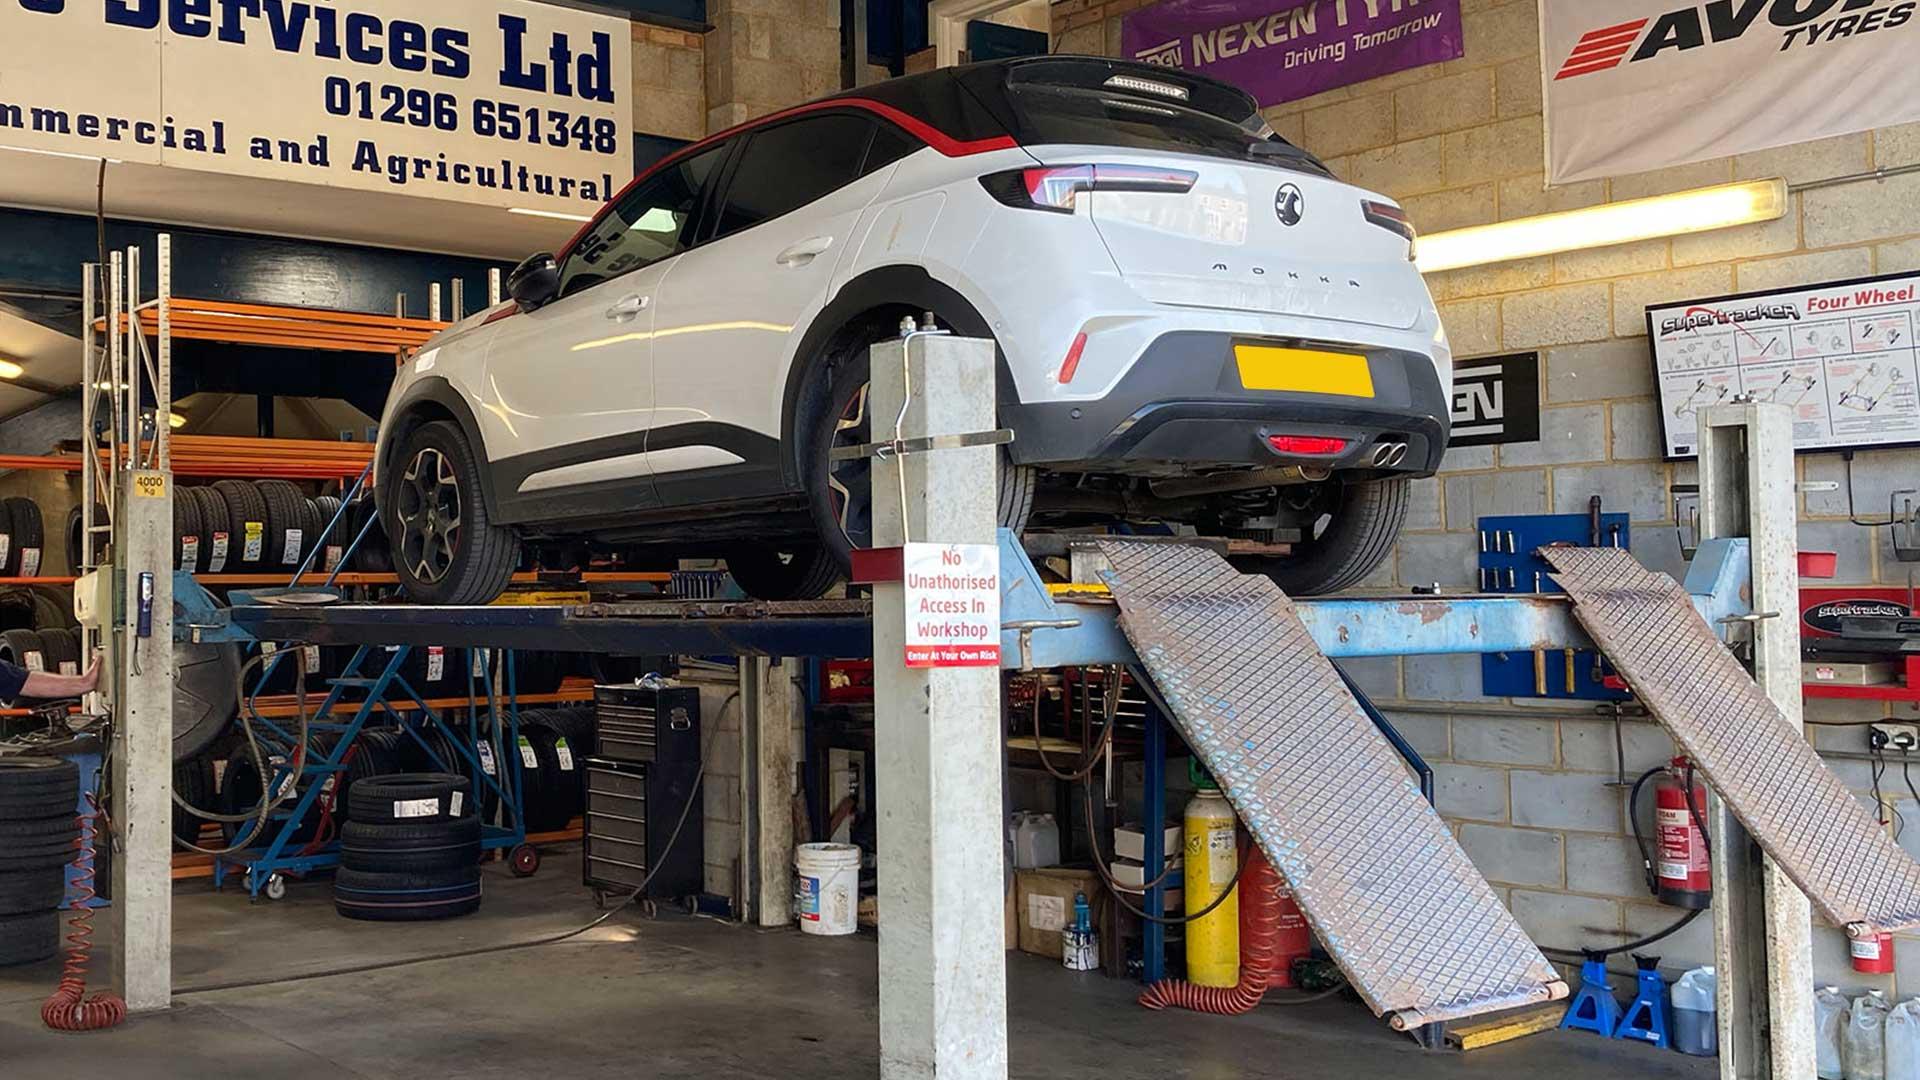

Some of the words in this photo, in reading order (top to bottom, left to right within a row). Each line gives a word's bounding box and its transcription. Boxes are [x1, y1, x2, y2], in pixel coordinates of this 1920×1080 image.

[1192, 2, 1318, 67] NEXEN
[1284, 41, 1346, 69] Driving
[1352, 12, 1442, 51] Tomorrow
[1629, 0, 1894, 63] AVO
[1779, 1, 1917, 52] TYRES
[498, 13, 615, 104] Ltd
[325, 76, 458, 132] 01296
[472, 99, 617, 155] 651348
[250, 135, 330, 168] and
[351, 140, 613, 202] Agricultural
[1212, 263, 1360, 288] MOKKA
[1806, 295, 1850, 312] Four
[1854, 284, 1915, 306] Wheel
[136, 476, 163, 487] 4000
[942, 550, 962, 566] No
[908, 573, 996, 590] Unathorised
[919, 597, 968, 614] Access
[971, 597, 986, 614] In
[917, 621, 988, 641] Workshop
[907, 651, 929, 661] Enter
[930, 651, 940, 661] At
[941, 651, 958, 661] Your
[959, 651, 979, 661] Own
[980, 650, 998, 661] Risk
